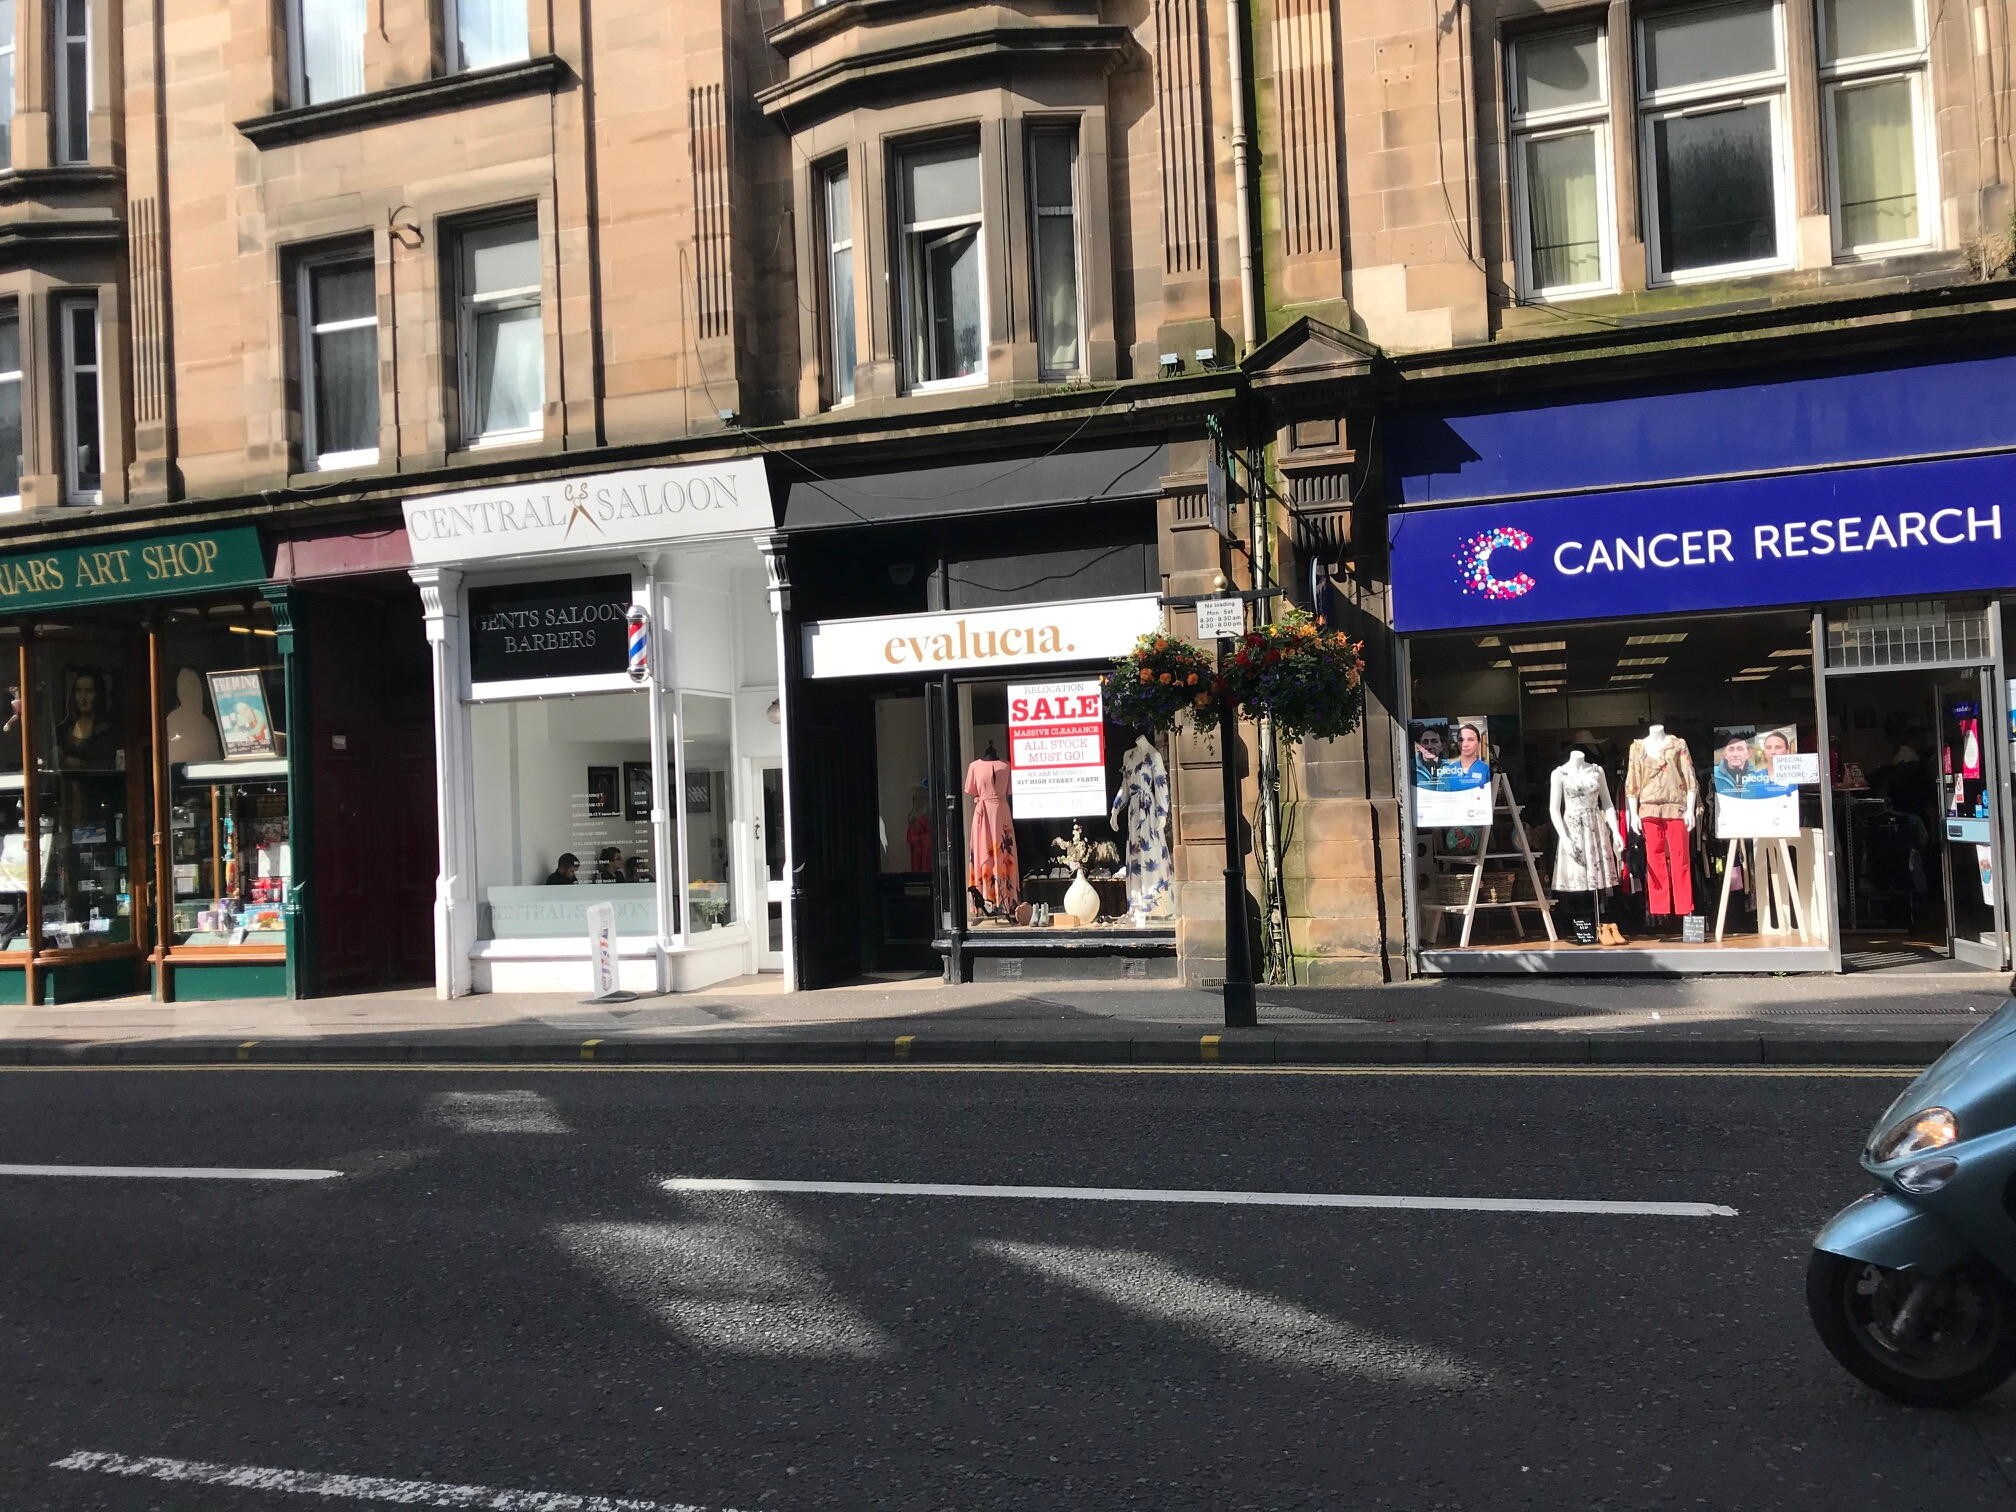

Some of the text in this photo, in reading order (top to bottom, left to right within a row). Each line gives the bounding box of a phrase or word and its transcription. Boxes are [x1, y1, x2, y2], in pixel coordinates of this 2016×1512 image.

[410, 475, 739, 541] CENTRAL SALOON
[1553, 504, 2002, 575] CANCER RESEARCH
[75, 550, 131, 588] ART
[142, 540, 218, 580] SHOP
[474, 602, 629, 632] GENTS SALOON
[504, 629, 597, 653] BARBERS
[884, 619, 1075, 665] evalucia.
[1024, 683, 1085, 695] RELOCATION
[1012, 694, 1099, 722] SALE
[1014, 725, 1099, 737] MASSIVE CLEARANCE
[1024, 738, 1089, 751] ALL STOCK
[1028, 750, 1084, 763] MUST GO!
[1436, 765, 1469, 777] pledge
